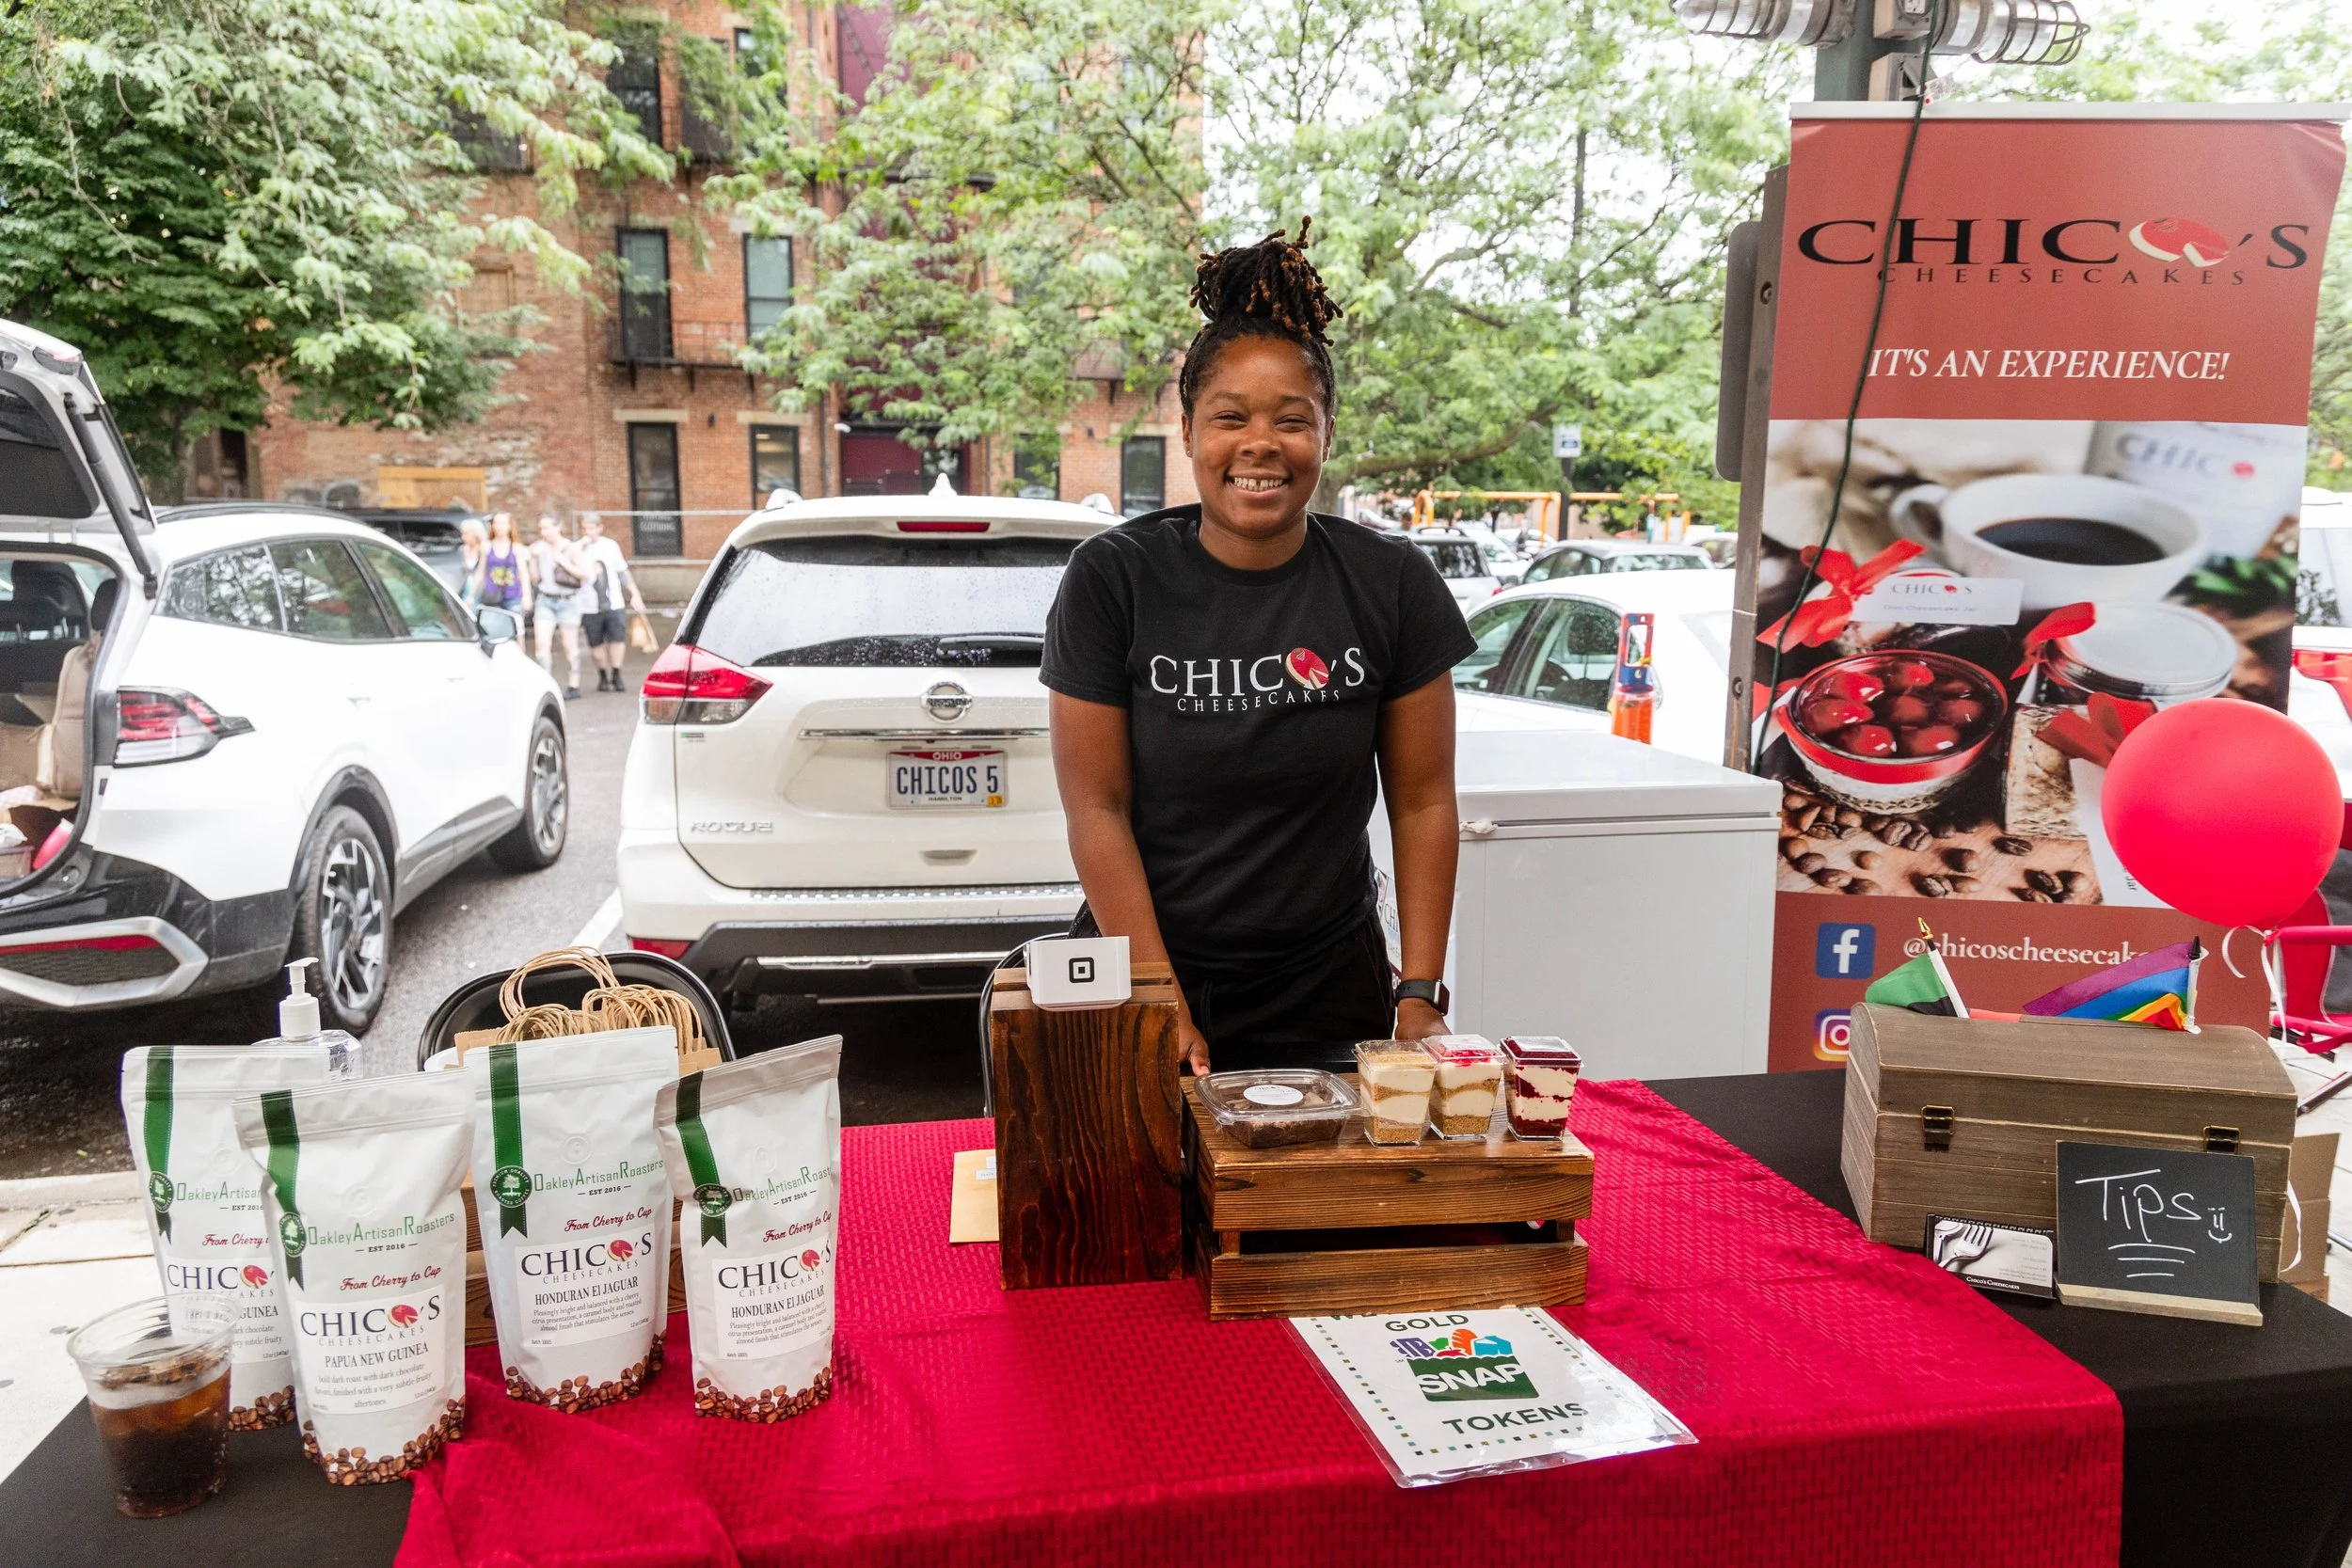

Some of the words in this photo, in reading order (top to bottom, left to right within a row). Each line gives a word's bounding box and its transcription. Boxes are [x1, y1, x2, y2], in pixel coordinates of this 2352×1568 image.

[1797, 215, 2312, 270] CHICO'S
[1878, 267, 2245, 286] CHEESECAKES
[1869, 348, 1929, 377] IT'S
[1935, 348, 1991, 377] AN
[1997, 349, 2231, 381] EXPERIENCE!
[1150, 646, 1365, 694] CHICO'S
[1177, 689, 1341, 713] CHEESECAKES
[932, 752, 962, 761] OHIO
[897, 765, 977, 795] CHICOS
[986, 765, 998, 794] 5
[691, 820, 773, 833] ROGUE
[533, 1159, 664, 1193] OakleyArtisanRoasters
[604, 1185, 622, 1194] 2016
[733, 1165, 832, 1203] OakleyArtisanRoast
[780, 1196, 792, 1205] EST
[793, 1192, 808, 1201] 2016
[2074, 1168, 2202, 1243] Tips
[308, 1212, 455, 1246] OakleyArtisanRoasters
[564, 1218, 590, 1232] From
[593, 1215, 624, 1228] Cherry
[626, 1212, 635, 1222] to
[637, 1207, 653, 1220] Cup
[762, 1228, 787, 1243] From
[788, 1220, 815, 1236] Cherry
[815, 1215, 822, 1227] to
[822, 1210, 832, 1223] Cu
[202, 1233, 229, 1246] From
[231, 1233, 263, 1249] Cherry
[385, 1243, 405, 1251] 2016
[520, 1231, 653, 1277] CHICO'S
[167, 1263, 276, 1291] CHICO'
[339, 1276, 367, 1291] From
[372, 1274, 409, 1289] Cherry
[410, 1271, 421, 1283] to
[424, 1265, 442, 1279] Cup
[542, 1259, 640, 1285] CHEESECAKES
[718, 1239, 832, 1290] CHICO'S
[534, 1286, 591, 1307] HONDURAN
[602, 1275, 639, 1296] JAGUAR
[739, 1268, 825, 1298] CHEESECAKES
[300, 1294, 441, 1337] CHICO'S
[731, 1299, 786, 1319] HONDURAN
[795, 1283, 825, 1307] JAGUAR
[318, 1324, 424, 1347] CHEESECAKES
[1384, 1313, 1470, 1333] GOLD
[325, 1354, 358, 1369] PAPUA
[360, 1351, 386, 1367] NEW
[388, 1340, 429, 1362] GUINEA
[1418, 1362, 1527, 1395] SNAP
[1441, 1401, 1591, 1435] TOKENS
